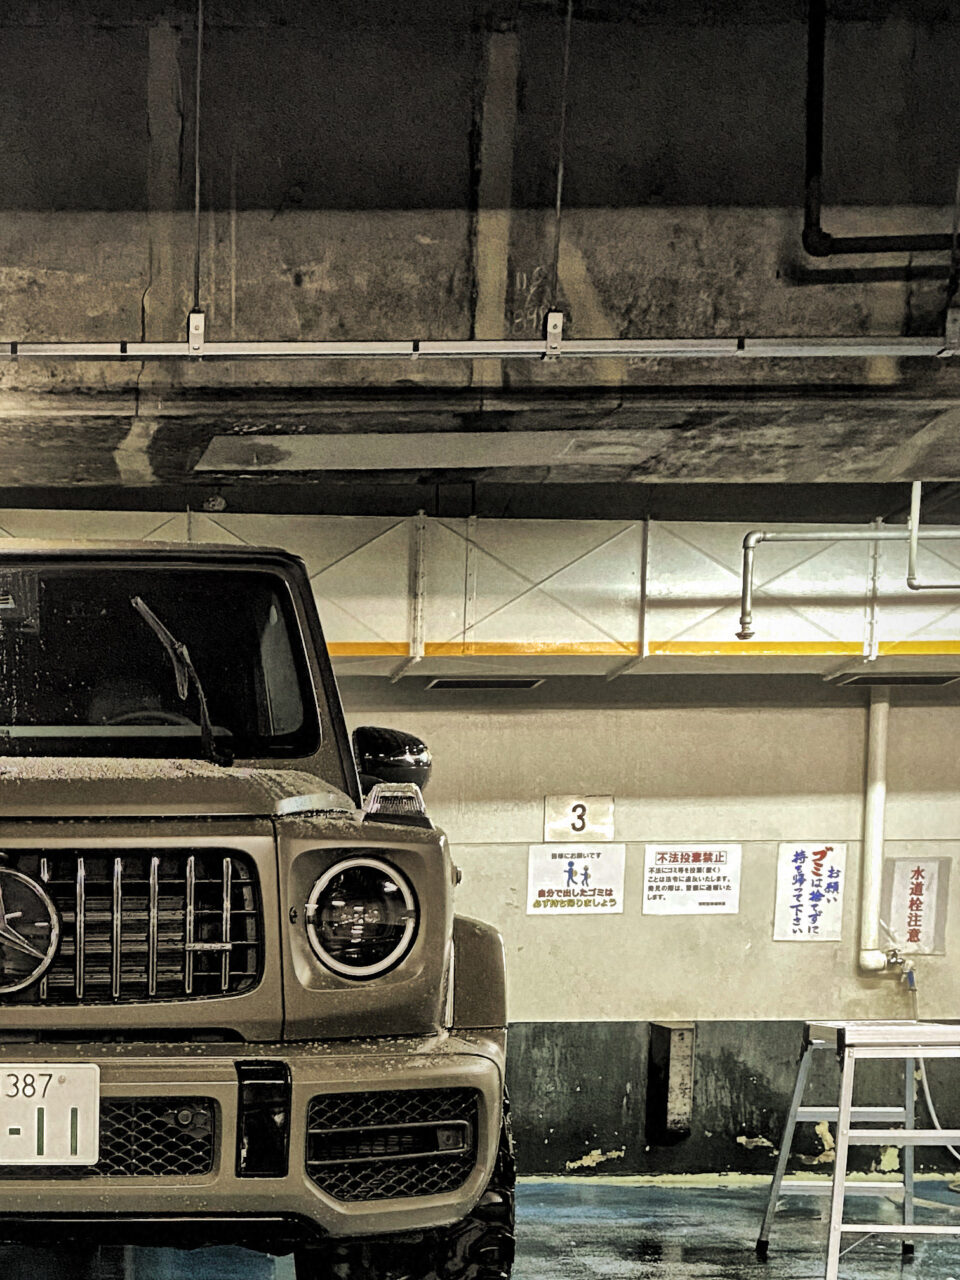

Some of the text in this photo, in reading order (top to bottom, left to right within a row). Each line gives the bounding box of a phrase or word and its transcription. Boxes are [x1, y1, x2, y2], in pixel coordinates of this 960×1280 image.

[570, 803, 587, 832] 3
[657, 852, 725, 863] 不法投棄禁止
[538, 888, 613, 898] 自分で出したゴミは
[789, 849, 808, 934] 持ち帰って下さい
[808, 846, 834, 934] ゴミは捨てずに
[824, 865, 842, 904] お願い
[906, 865, 925, 943] 水道栓注意
